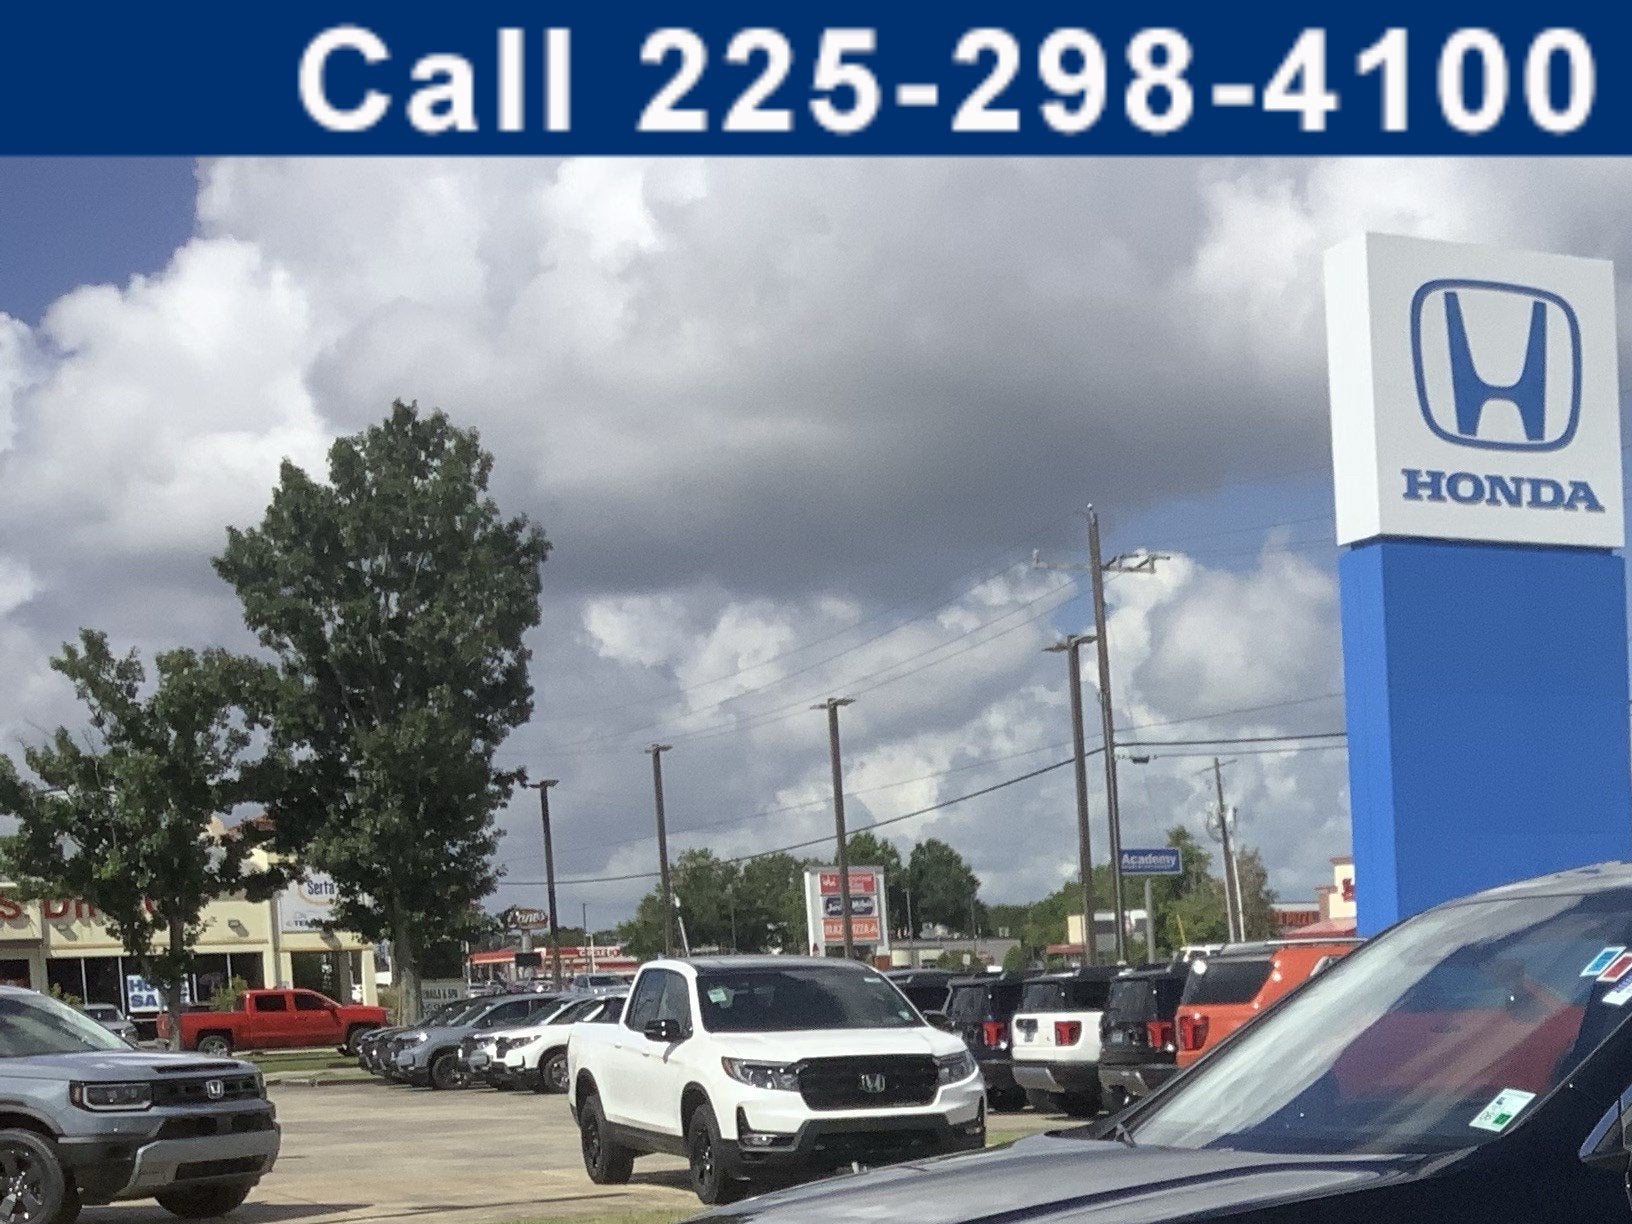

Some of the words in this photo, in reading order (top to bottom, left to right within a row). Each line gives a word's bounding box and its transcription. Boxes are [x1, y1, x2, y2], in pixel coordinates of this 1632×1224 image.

[1402, 468, 1605, 512] HONDA
[1121, 854, 1177, 867] Academy
[307, 880, 336, 895] Serta
